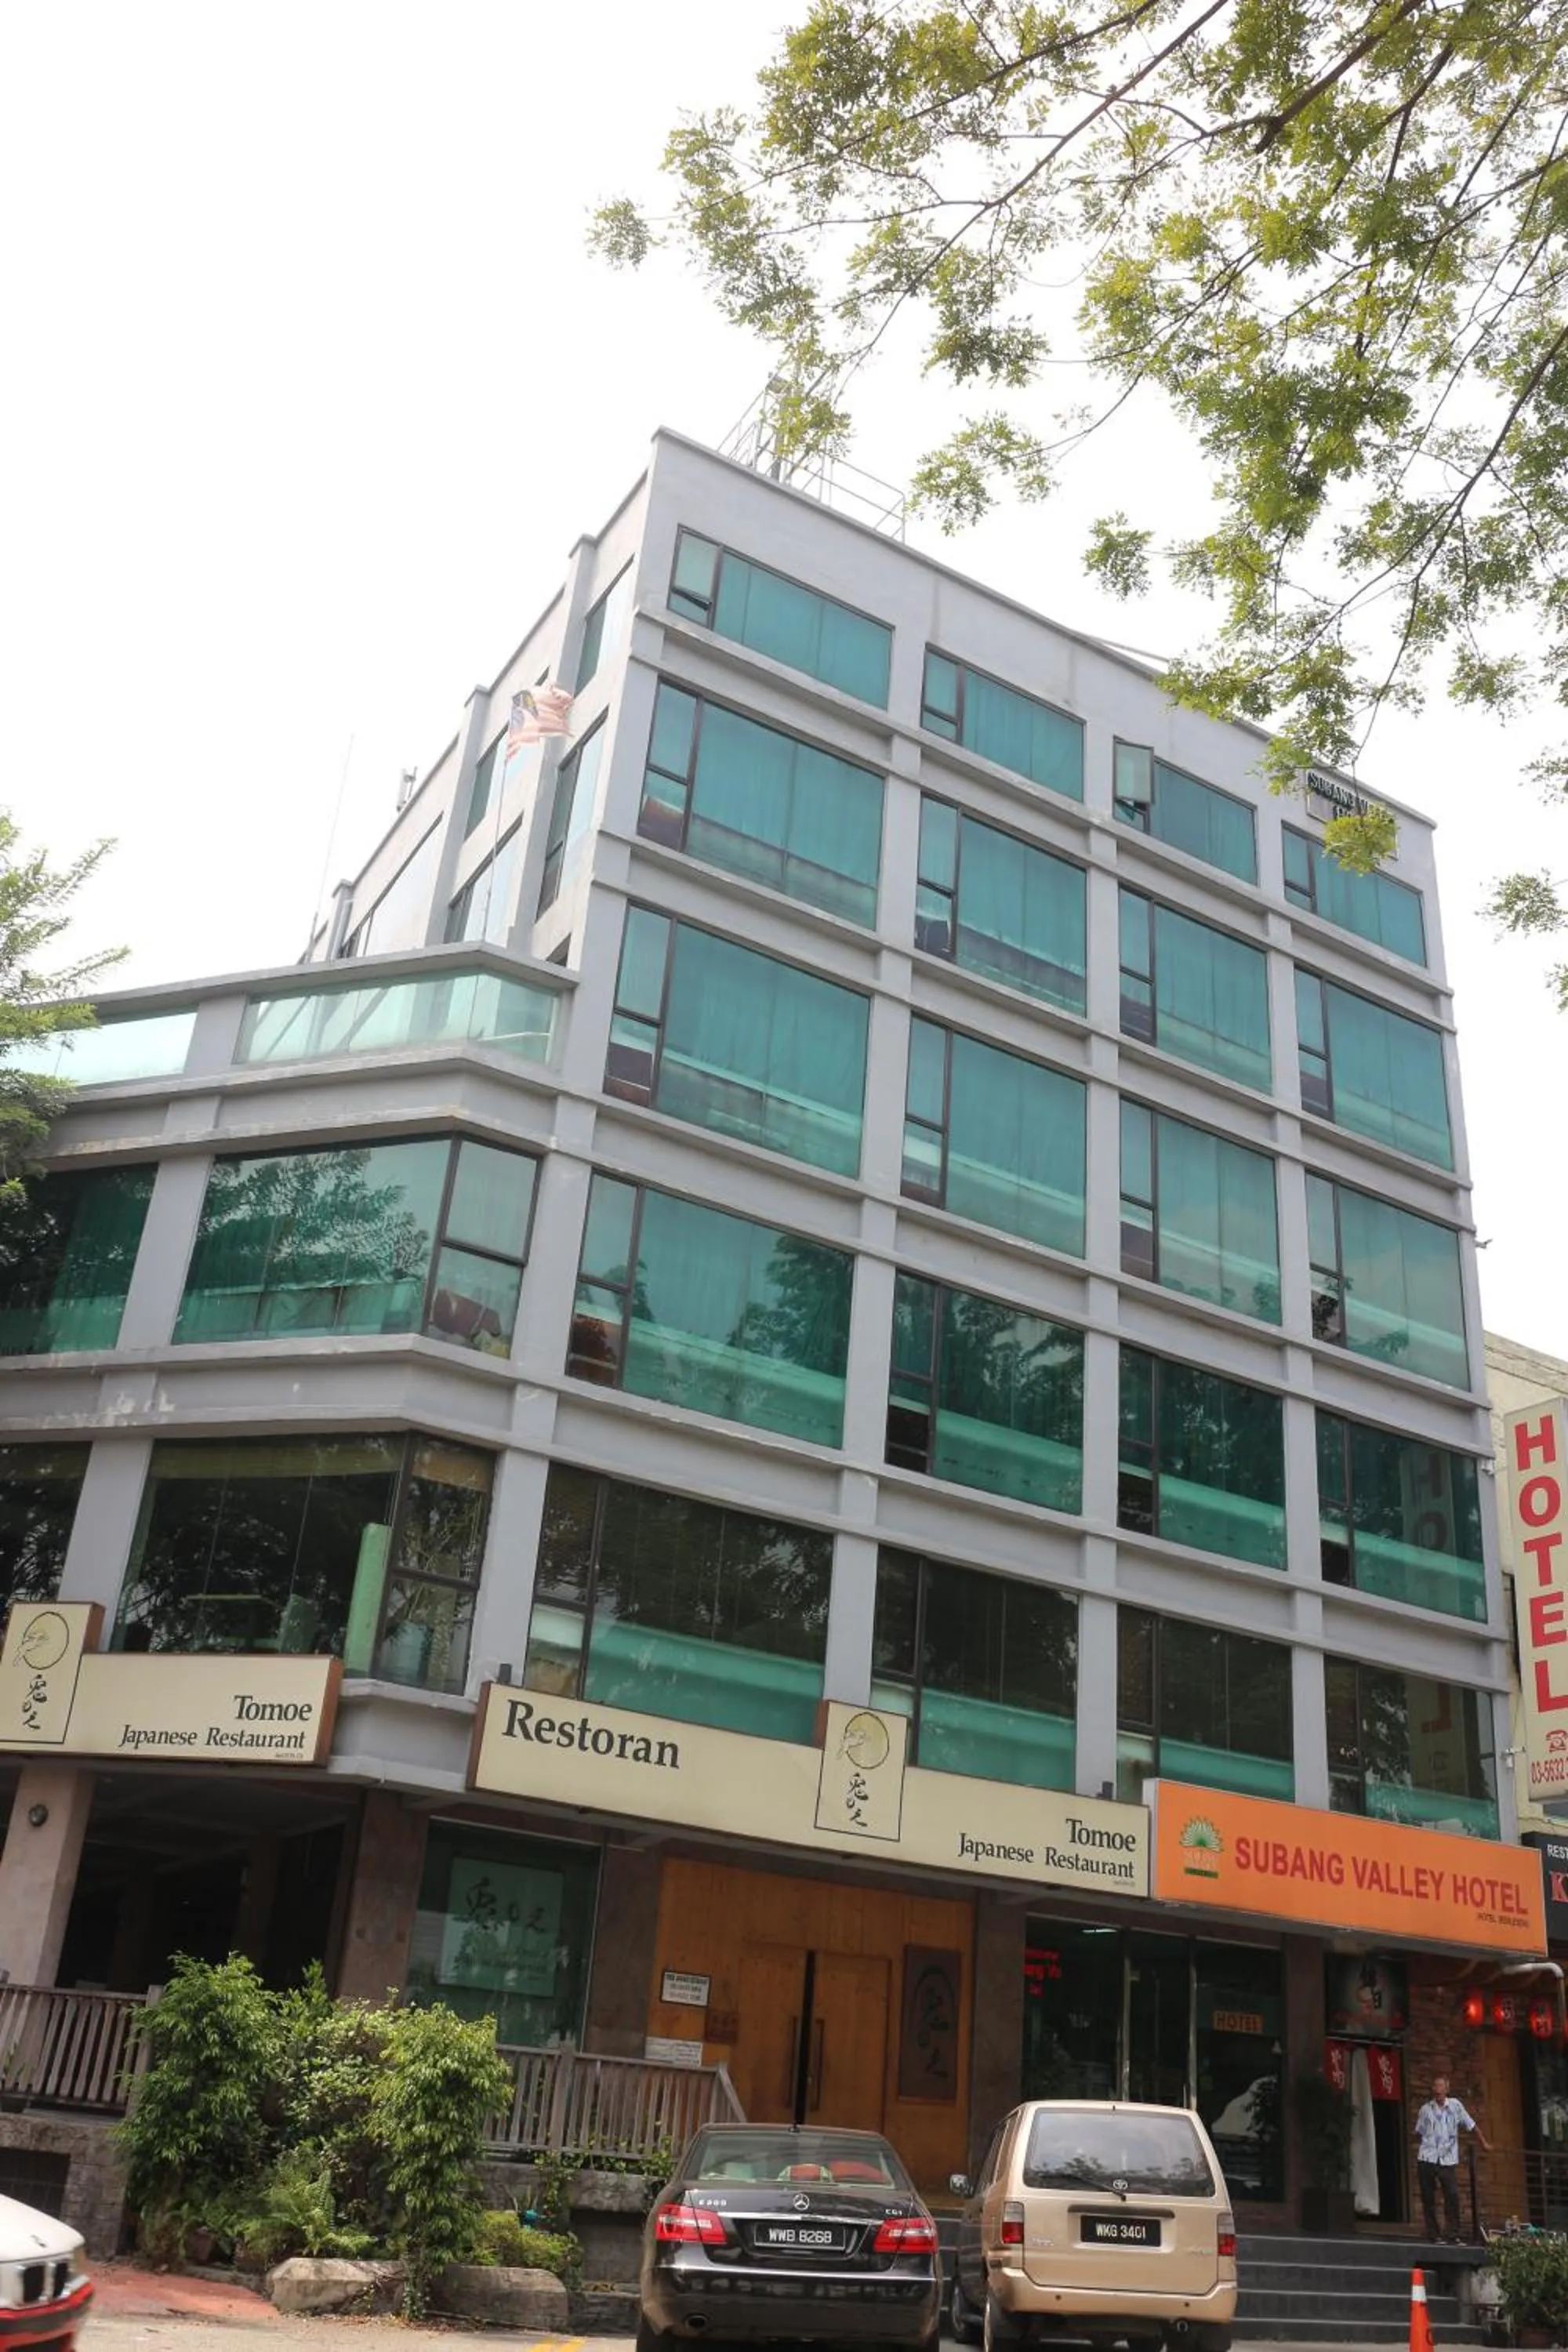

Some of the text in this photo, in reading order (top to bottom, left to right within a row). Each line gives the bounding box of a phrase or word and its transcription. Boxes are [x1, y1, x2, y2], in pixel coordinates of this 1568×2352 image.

[1514, 1415, 1568, 1712] HOTEL
[234, 1696, 312, 1722] Tomoe
[119, 1726, 305, 1749] Japanese Restaurant
[502, 1700, 679, 1769] Restoran
[1065, 1818, 1136, 1852] Tomoe
[958, 1833, 1134, 1878] Japanese Restaurant
[1235, 1837, 1529, 1915] SUBANG VALLEY HOTEL
[1217, 2013, 1258, 2032] HOTEL
[768, 2228, 795, 2241] WWB
[1096, 2223, 1117, 2237] WKG
